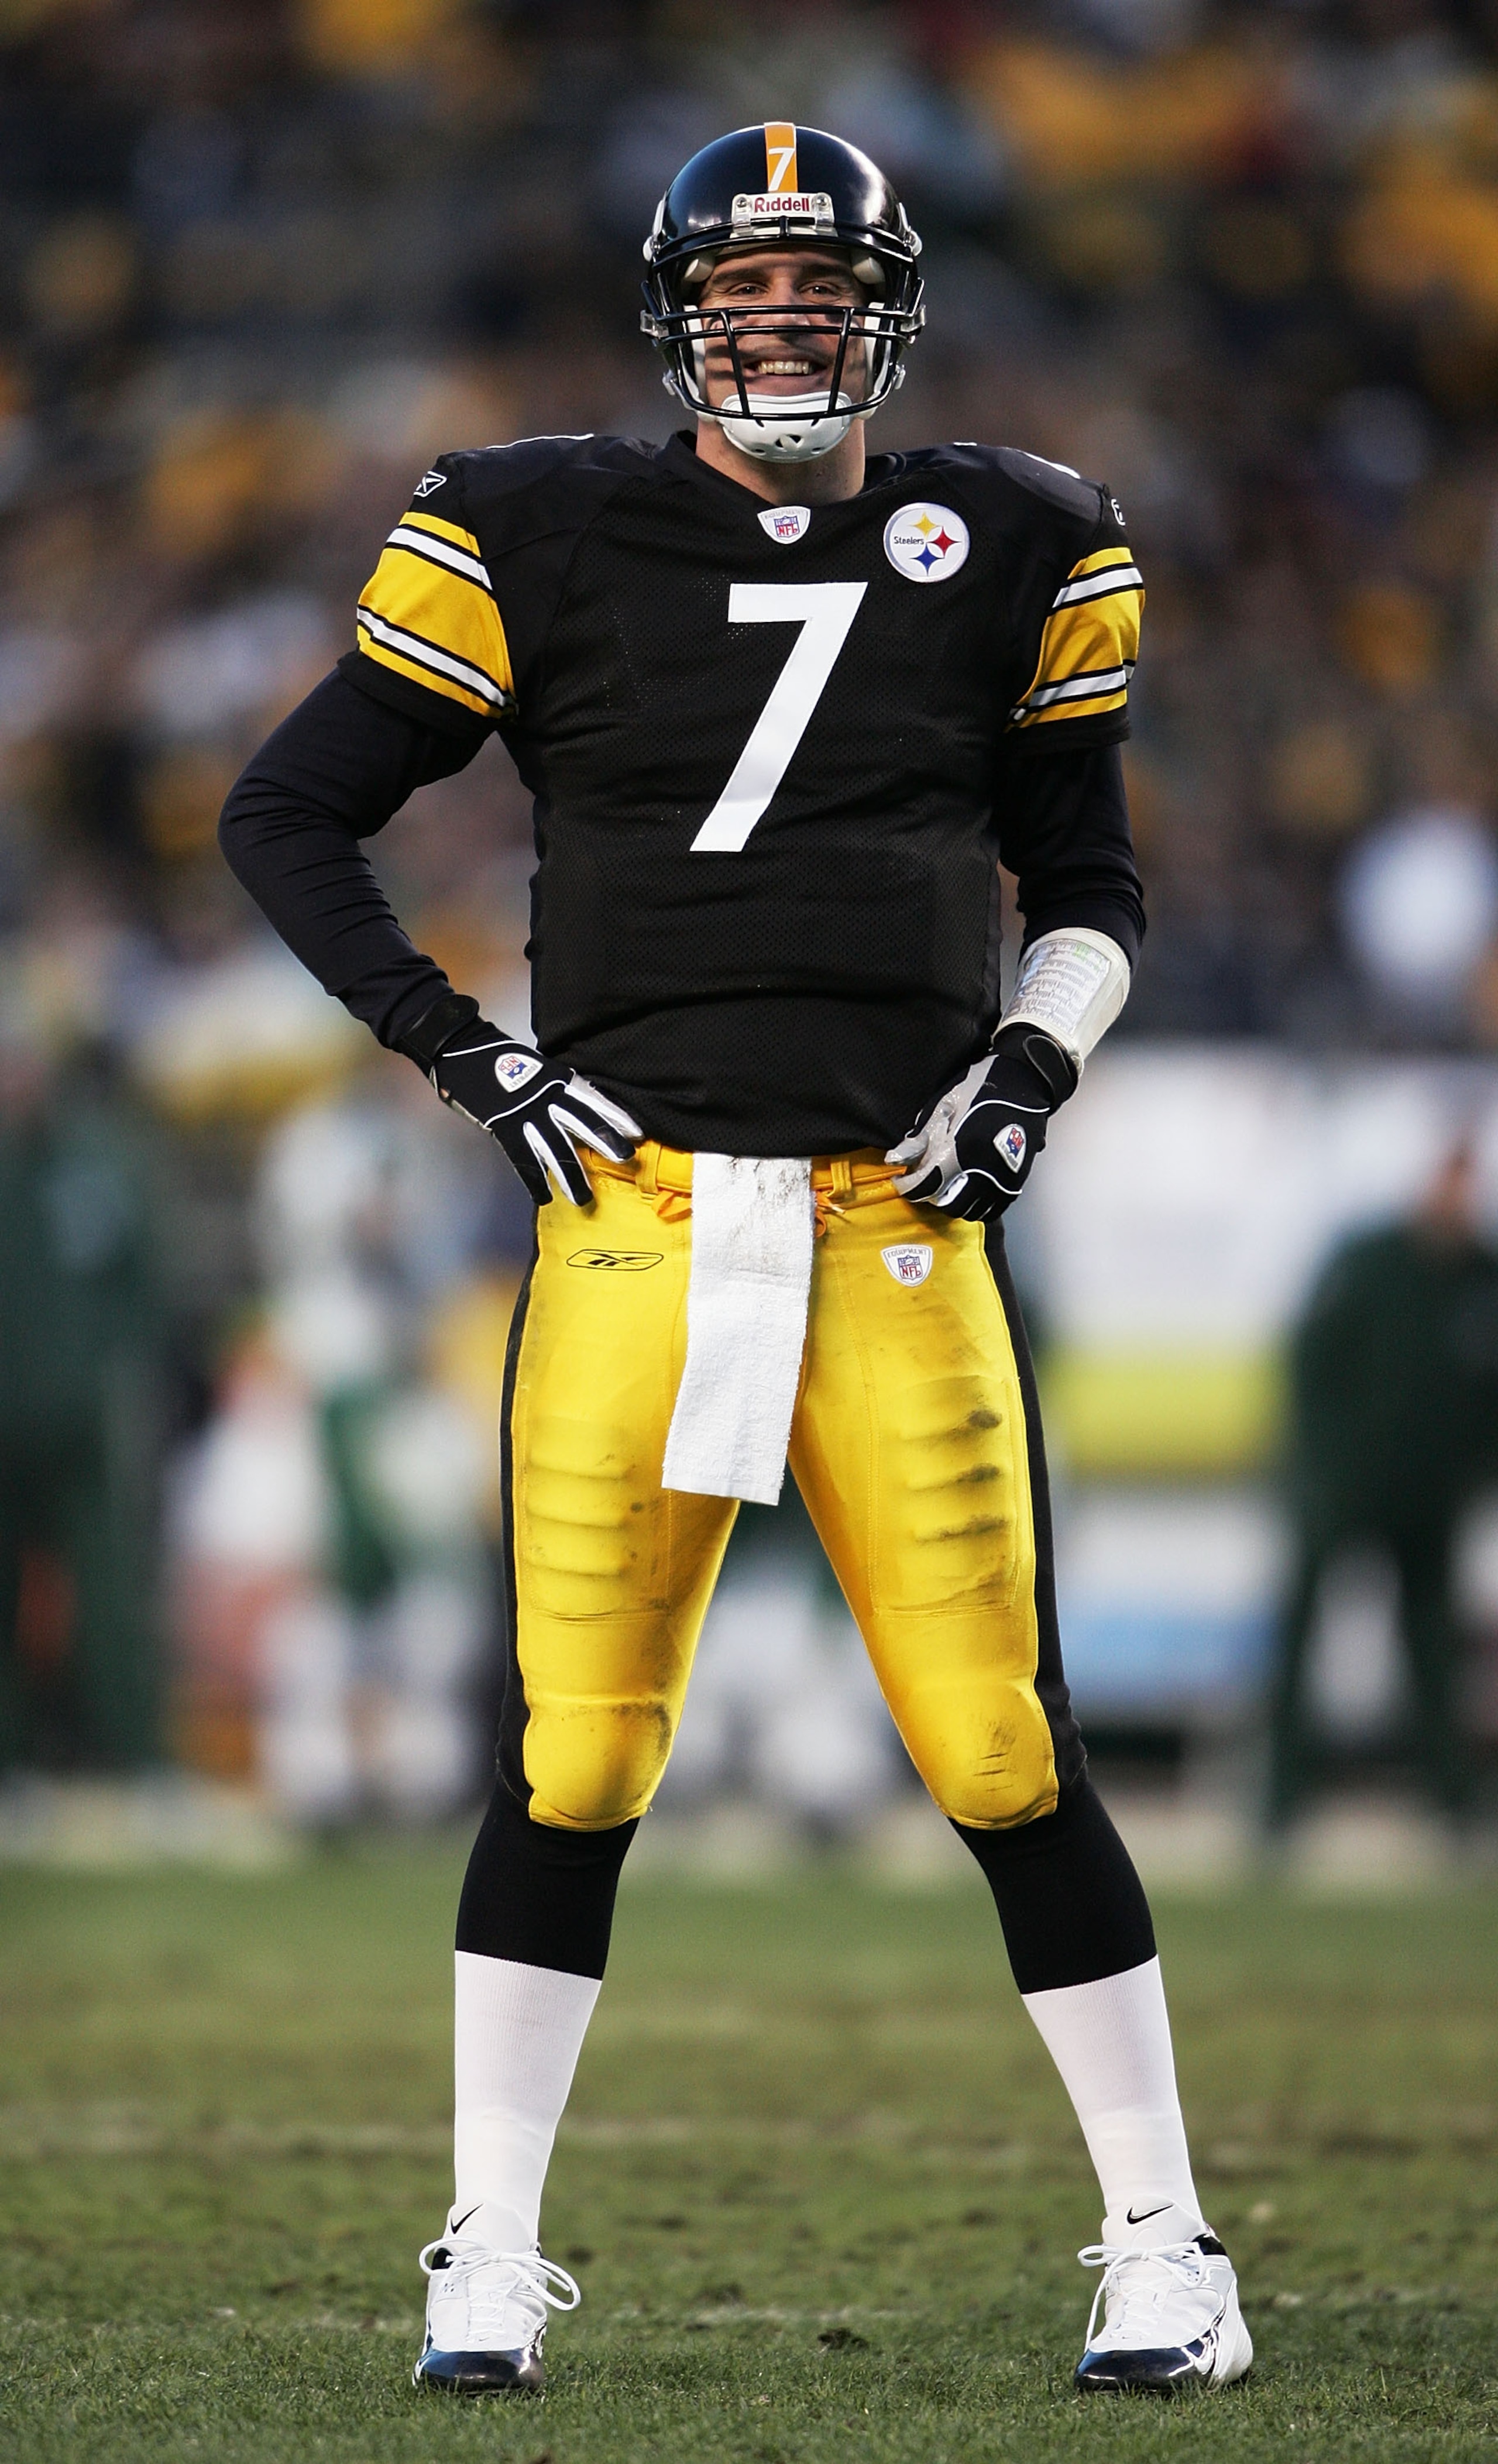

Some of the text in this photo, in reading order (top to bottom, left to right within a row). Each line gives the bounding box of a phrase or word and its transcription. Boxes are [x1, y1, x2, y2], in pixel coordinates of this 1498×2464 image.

[768, 147, 795, 192] 7
[754, 197, 809, 213] Riddell
[778, 523, 798, 536] NFL
[894, 535, 925, 545] Steelers
[689, 582, 868, 853] 7
[901, 1264, 922, 1277] NFL
